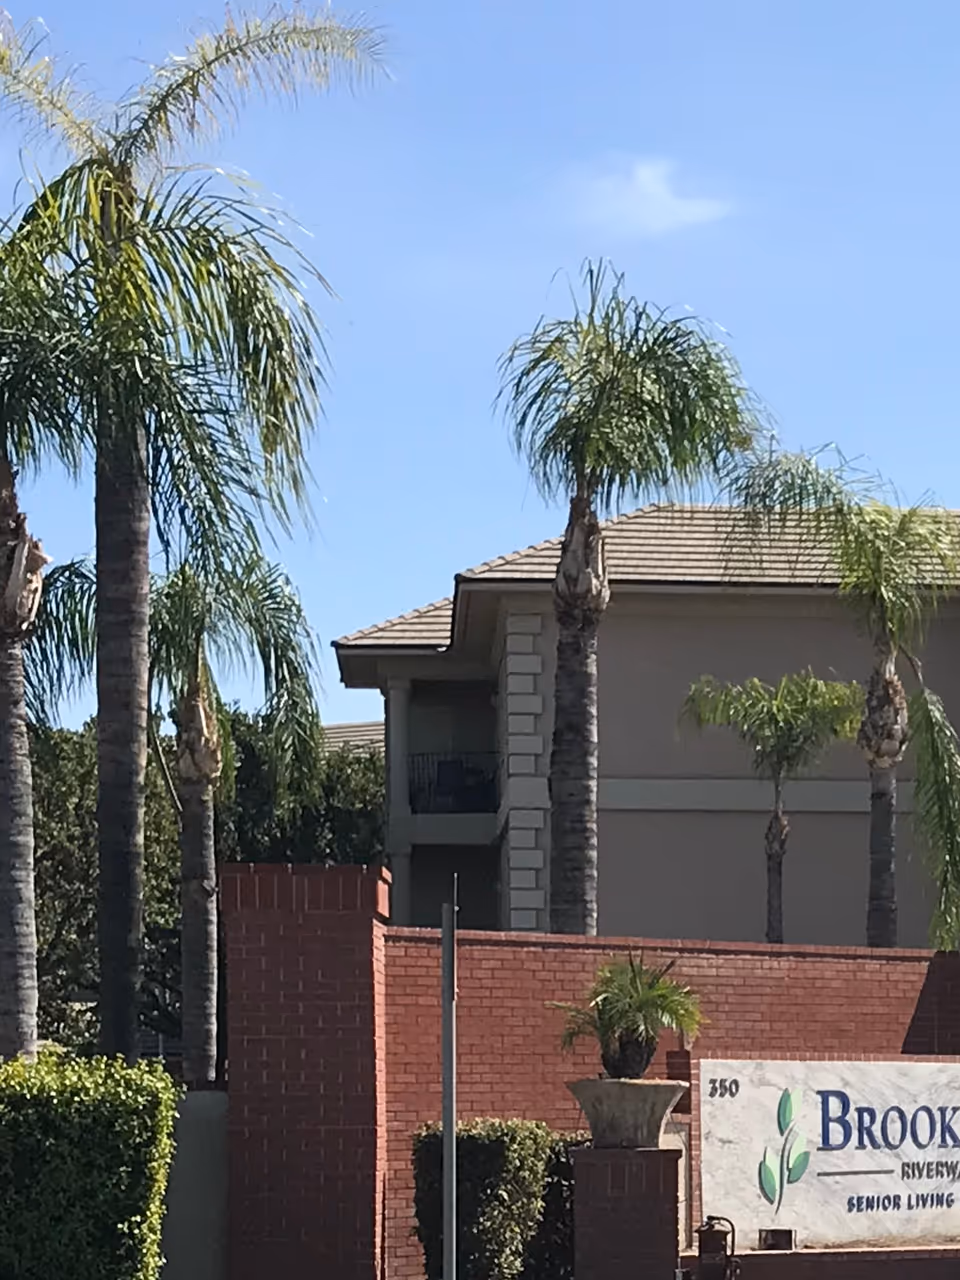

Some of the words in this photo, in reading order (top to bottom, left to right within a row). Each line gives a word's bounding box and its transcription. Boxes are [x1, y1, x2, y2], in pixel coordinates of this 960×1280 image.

[708, 1078, 740, 1098] 350
[847, 1194, 902, 1213] SENIOR
[907, 1192, 955, 1210] LIVING
